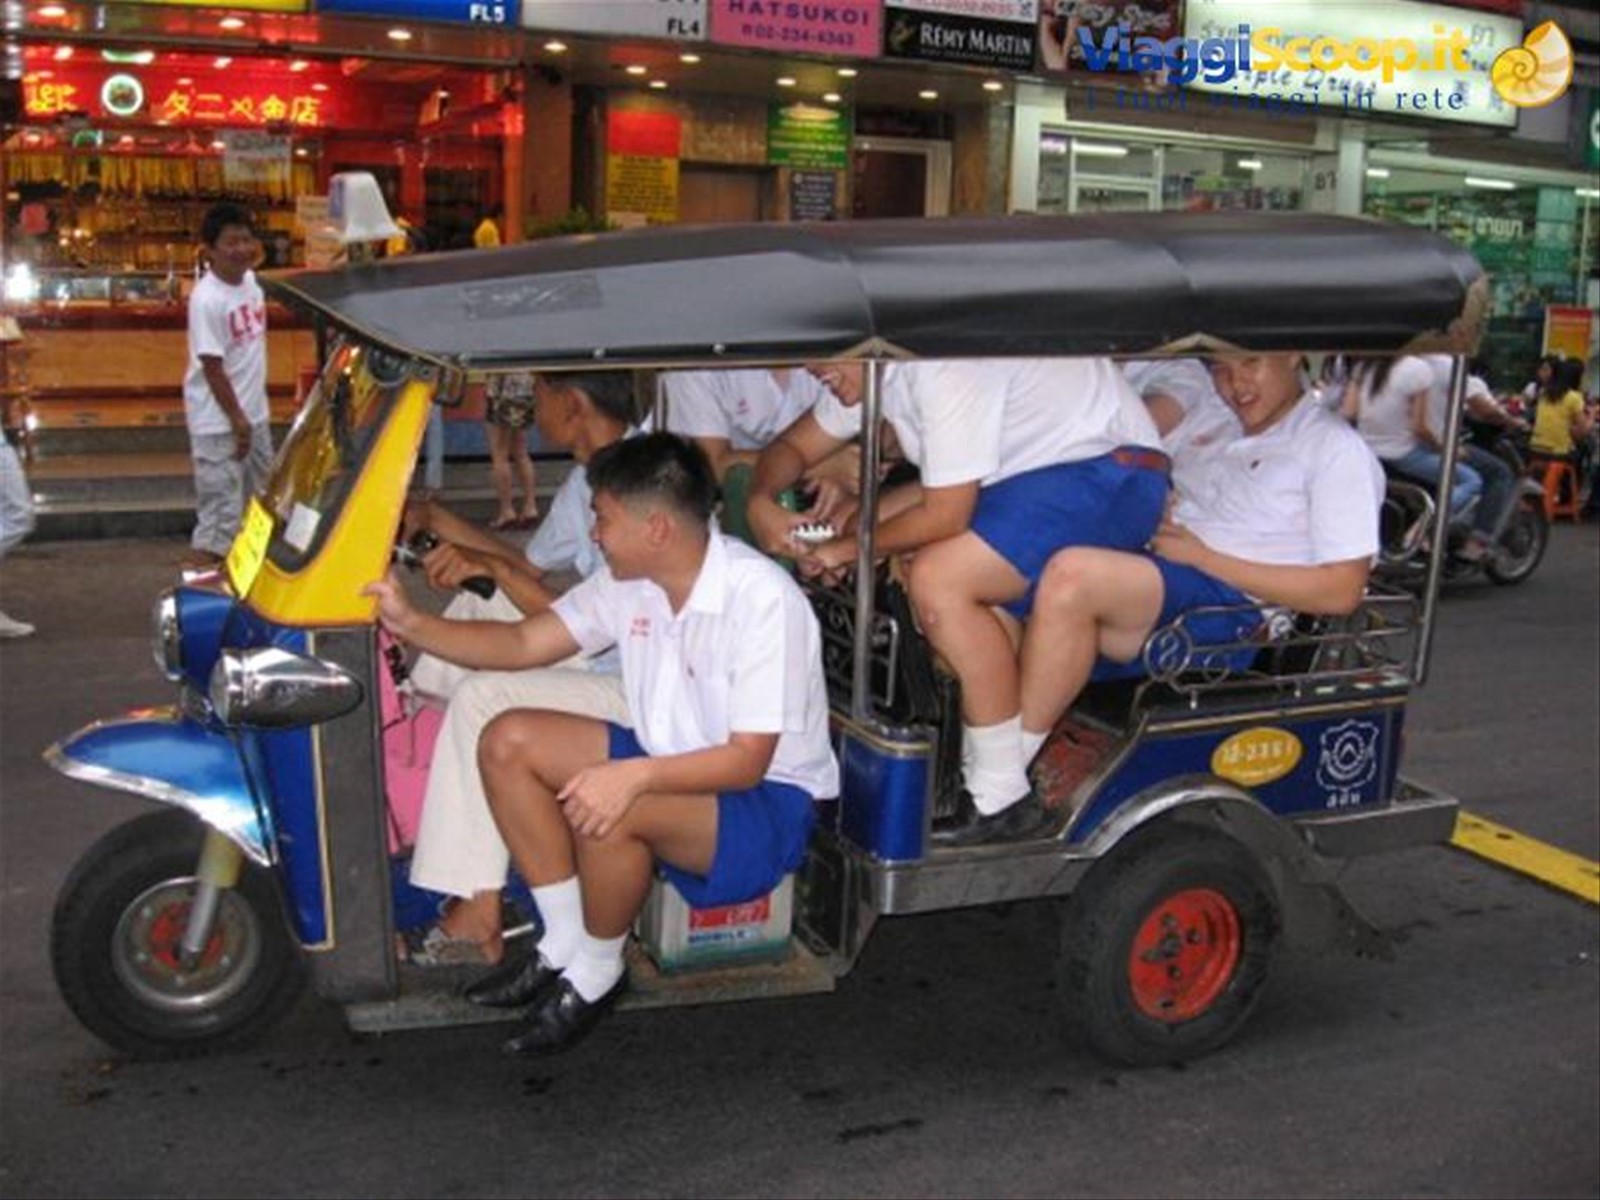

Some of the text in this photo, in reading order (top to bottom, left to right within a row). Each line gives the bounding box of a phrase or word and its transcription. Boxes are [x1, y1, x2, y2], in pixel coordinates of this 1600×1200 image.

[470, 4, 506, 22] FL5
[728, 0, 869, 26] HATSUKOI
[667, 17, 699, 35] FL4
